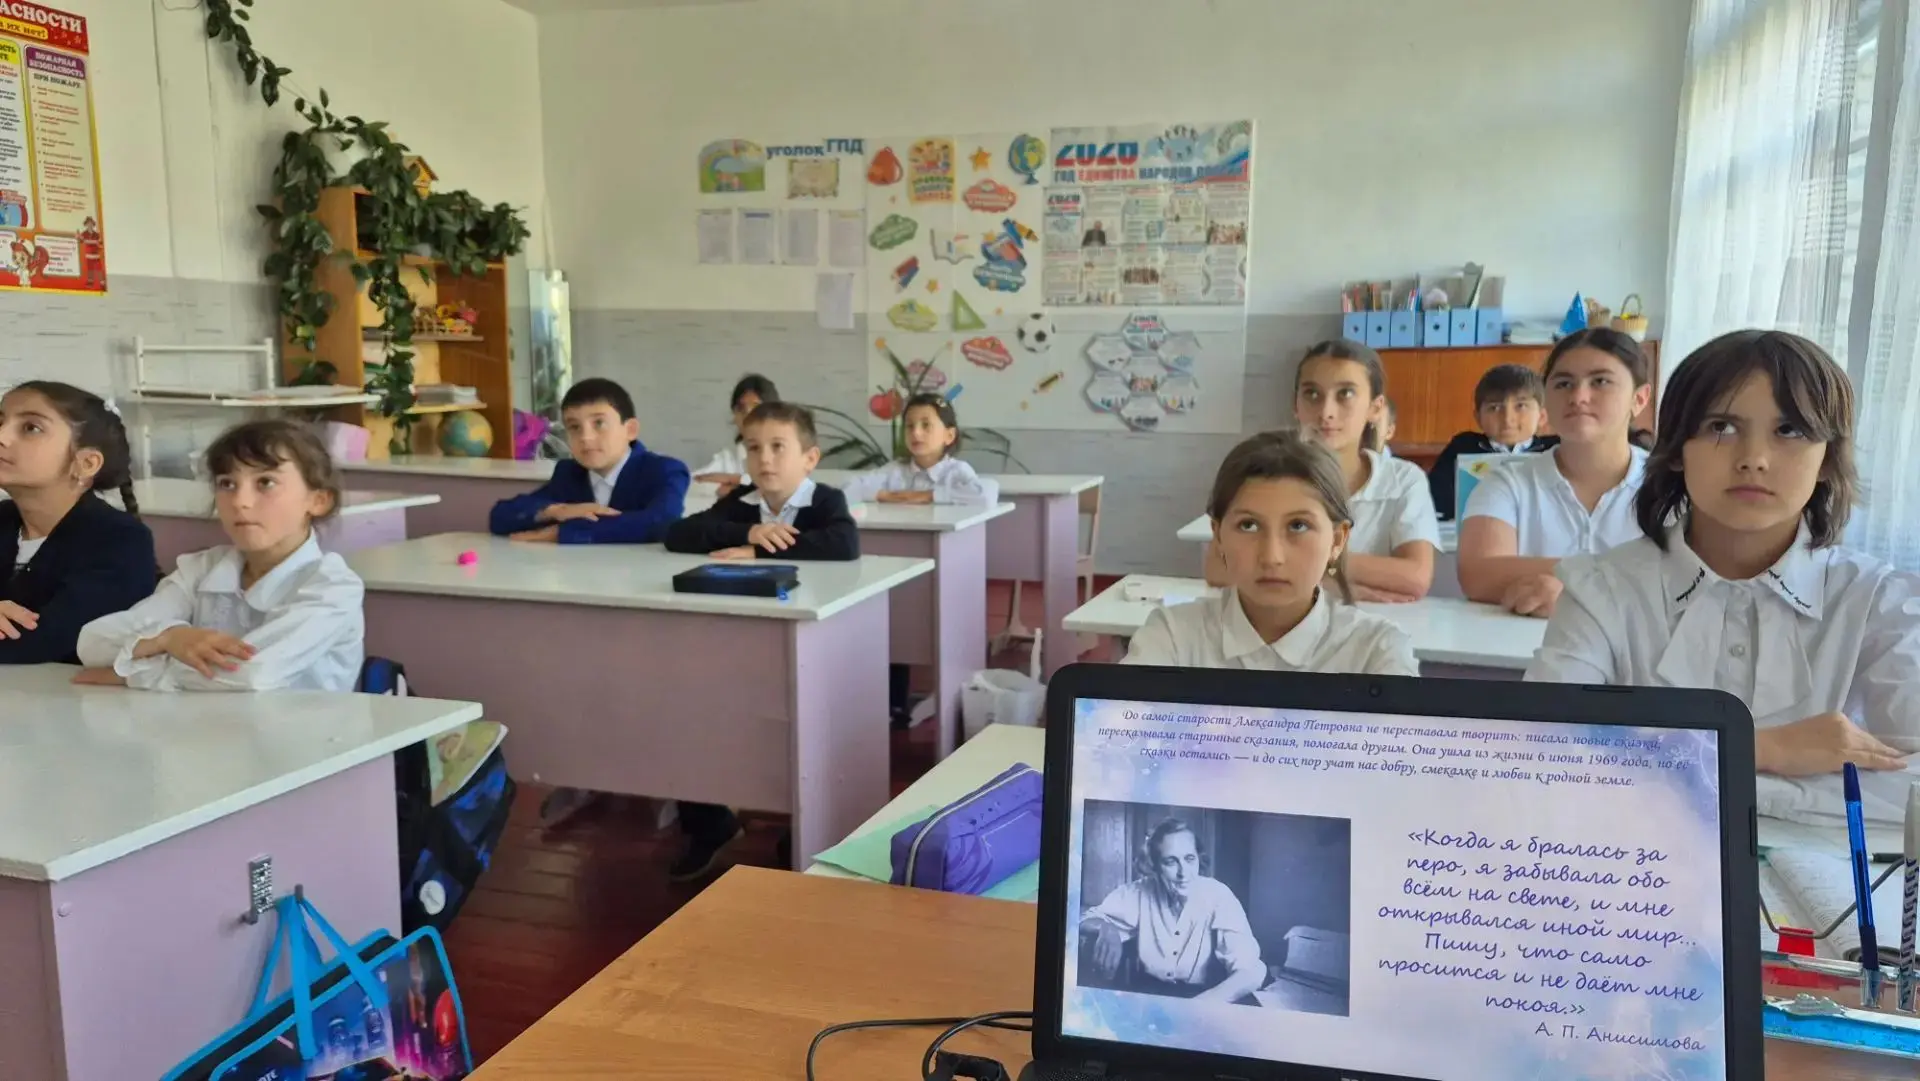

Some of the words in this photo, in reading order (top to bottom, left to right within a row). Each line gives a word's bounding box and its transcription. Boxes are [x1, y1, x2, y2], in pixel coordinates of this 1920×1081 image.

[765, 145, 824, 160] уголок
[825, 137, 864, 155] ГПД
[1122, 709, 1139, 720] До
[1141, 711, 1174, 722] самой
[1177, 714, 1232, 727] старости
[1233, 716, 1301, 731] Александра
[1303, 718, 1362, 734] Петровна
[1366, 726, 1379, 734] не
[1382, 727, 1458, 739] переставала
[1461, 730, 1521, 743] творить:
[1525, 733, 1568, 744] писала
[1572, 737, 1611, 747] новые
[1098, 727, 1177, 740] пересказывала
[1179, 732, 1242, 745] старинные
[1243, 736, 1299, 748] сказания,
[1303, 739, 1358, 751] помогала
[1361, 740, 1407, 755] другим.
[1412, 743, 1436, 755] Она
[1438, 747, 1471, 760] ушла
[1475, 749, 1489, 759] из
[1492, 751, 1533, 762] жизни
[1537, 752, 1545, 762] 6
[1548, 754, 1583, 764] июня
[1588, 754, 1618, 766] 1969
[1621, 756, 1652, 769] года,
[1657, 761, 1673, 769] но
[1139, 747, 1177, 760] сказки
[1179, 750, 1231, 761] остались
[1252, 754, 1260, 763] и
[1262, 752, 1275, 764] до
[1278, 756, 1299, 768] сих
[1300, 758, 1322, 770] пор
[1323, 759, 1355, 771] учат
[1357, 762, 1378, 771] нас
[1380, 760, 1417, 776] добру,
[1421, 765, 1478, 780] смекалке
[1481, 769, 1490, 778] и
[1491, 767, 1532, 780] любви
[1544, 770, 1591, 786] родной
[1594, 776, 1635, 787] земле.
[1500, 839, 1522, 851] я
[1527, 835, 1630, 860] бралась
[1635, 847, 1668, 866] за
[1407, 858, 1467, 876] перо,
[1475, 862, 1498, 875] я
[1502, 862, 1622, 885] забывала
[1627, 871, 1671, 888] обо
[1403, 877, 1462, 898] всём
[1468, 887, 1502, 901] на
[1508, 887, 1580, 911] свете,
[1590, 898, 1611, 911] и
[1616, 900, 1675, 917] мне
[1378, 905, 1537, 930] открывался
[1542, 919, 1613, 937] иной
[1616, 928, 1697, 948] мир...
[1424, 932, 1506, 960] Пишу,
[1517, 944, 1575, 961] что
[1580, 950, 1653, 968] само
[1378, 958, 1507, 981] просится
[1513, 971, 1534, 984] и
[1540, 974, 1570, 989] не
[1575, 972, 1641, 993] даёт
[1645, 985, 1705, 1001] мне
[1535, 1021, 1554, 1037] А.
[1562, 1024, 1580, 1039] П.
[1586, 1027, 1707, 1050] Анисимова
